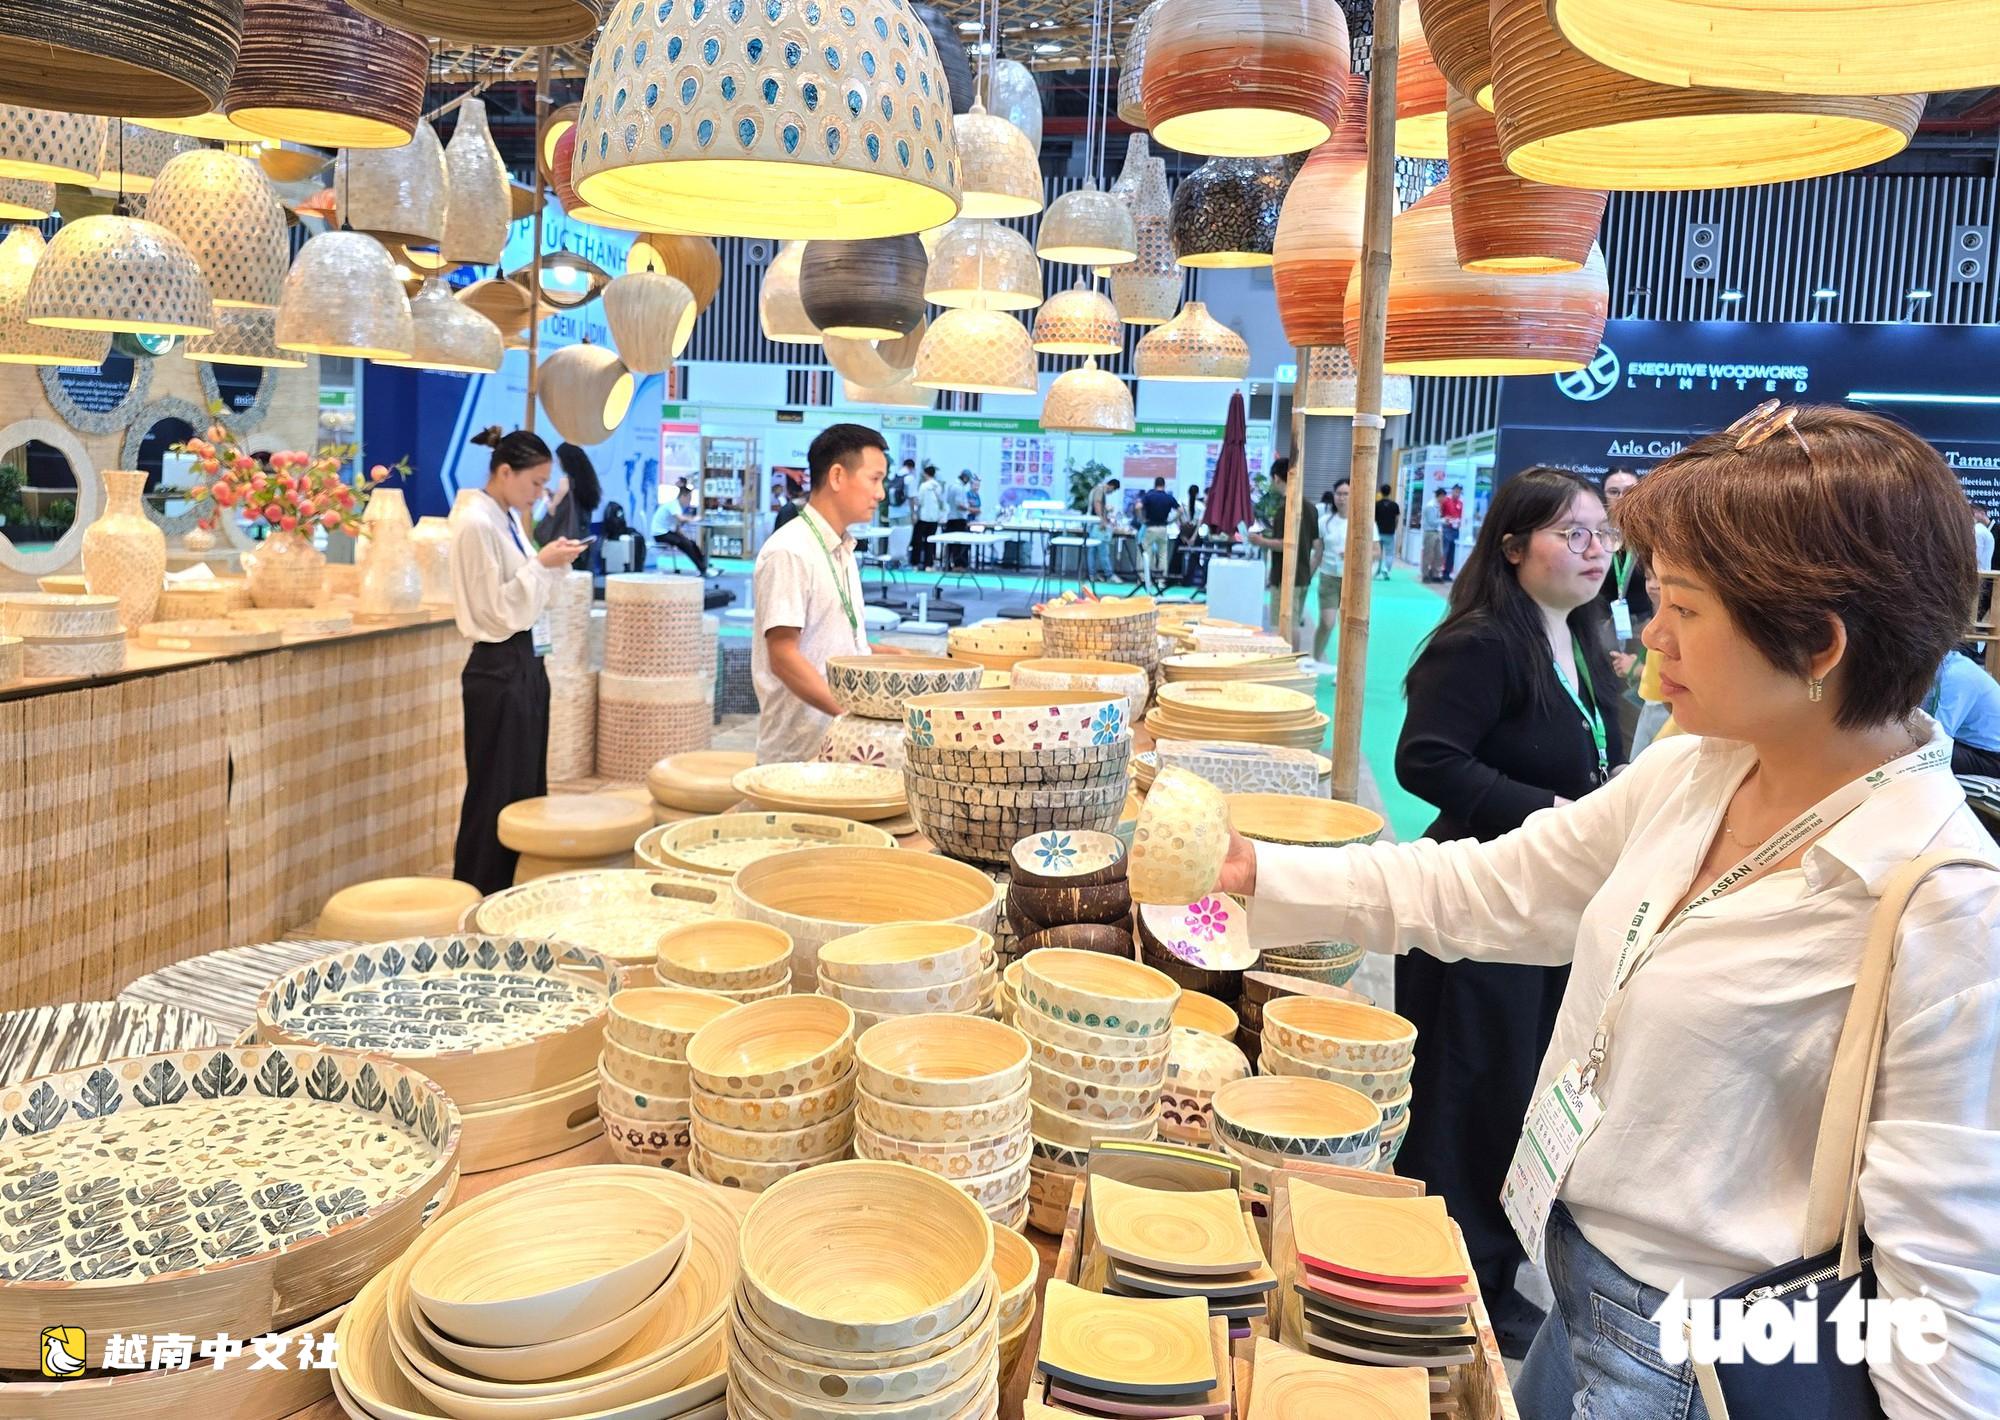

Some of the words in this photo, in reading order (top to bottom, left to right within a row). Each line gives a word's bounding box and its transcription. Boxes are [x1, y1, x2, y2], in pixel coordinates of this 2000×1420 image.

[1627, 377, 1808, 393] LIMITED
[1628, 362, 1707, 377] EXECUTIVE
[1708, 364, 1808, 380] WOODWORKS
[1606, 439, 1644, 455] Arlo
[1753, 831, 1791, 862] INTERNATIONAL
[1790, 812, 1818, 832] FURNITURE
[1764, 849, 1780, 864] HOME
[1779, 825, 1812, 852] ACCESSORIES
[1811, 817, 1824, 830] FAIR
[1711, 864, 1753, 897] ASEAN
[1562, 1074, 1584, 1114] VISITOR
